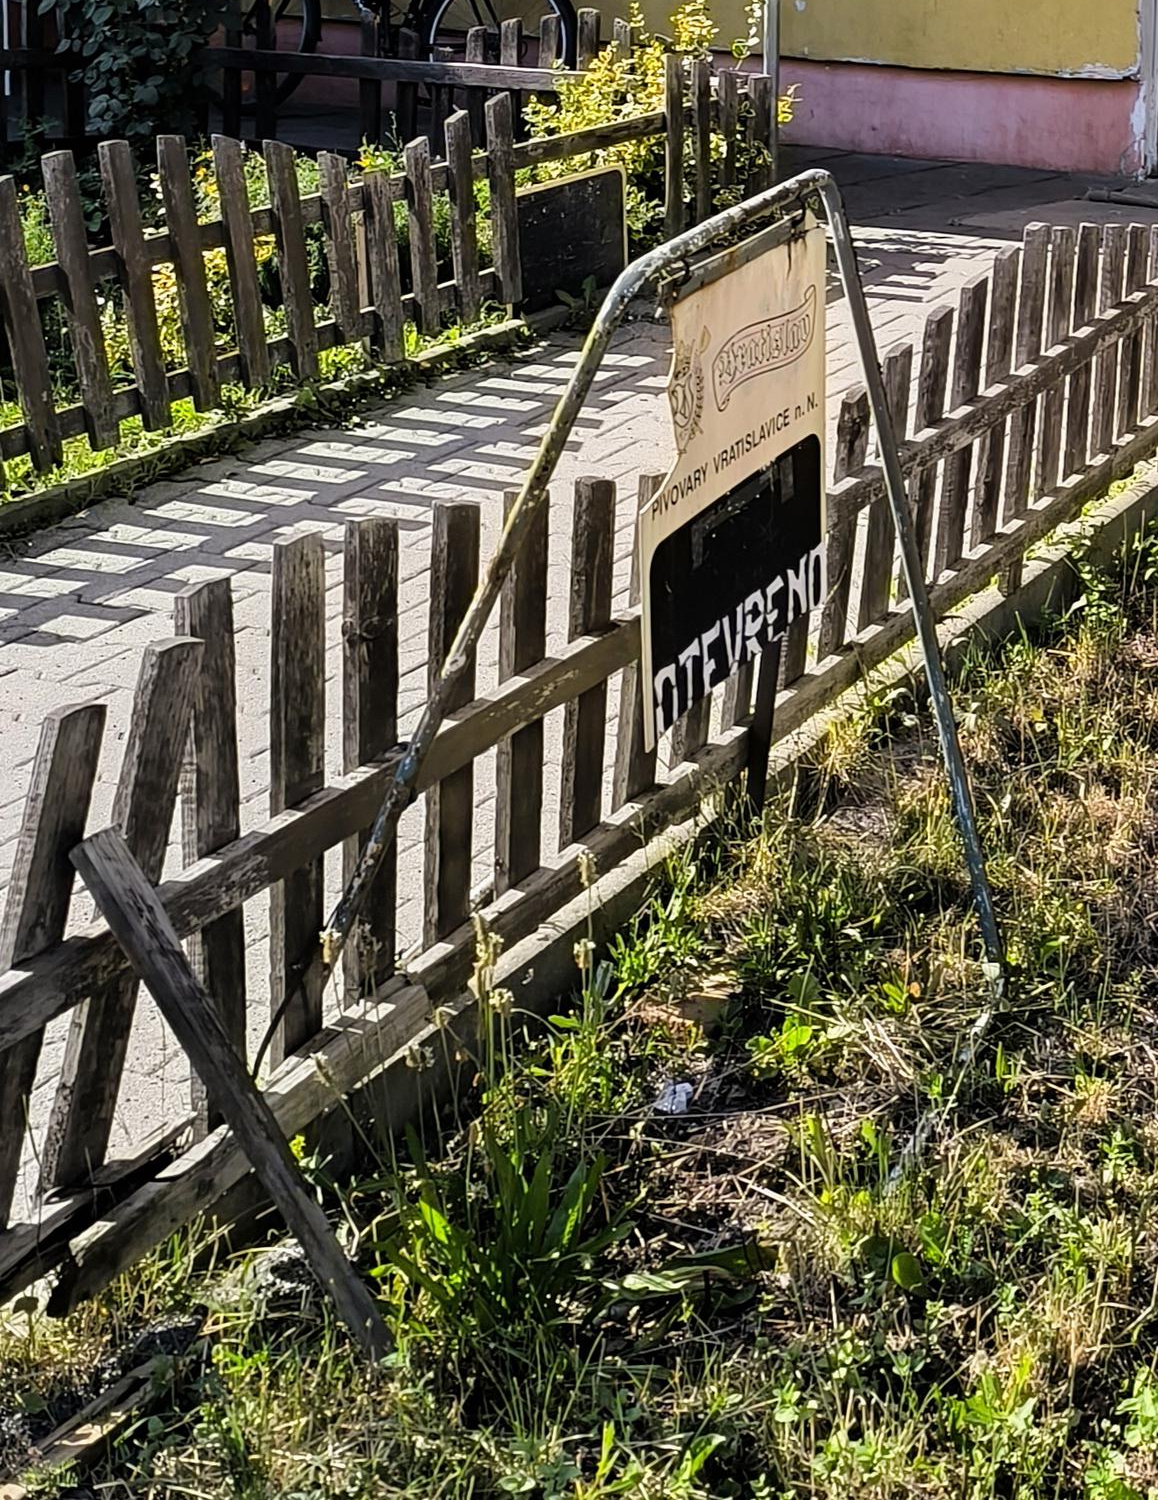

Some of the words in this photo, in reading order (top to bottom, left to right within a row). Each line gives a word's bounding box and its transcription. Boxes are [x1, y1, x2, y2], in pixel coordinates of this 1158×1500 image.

[652, 462, 709, 521] PIVOVARY
[713, 408, 790, 475] VRATISLAVICE
[806, 392, 819, 413] N.
